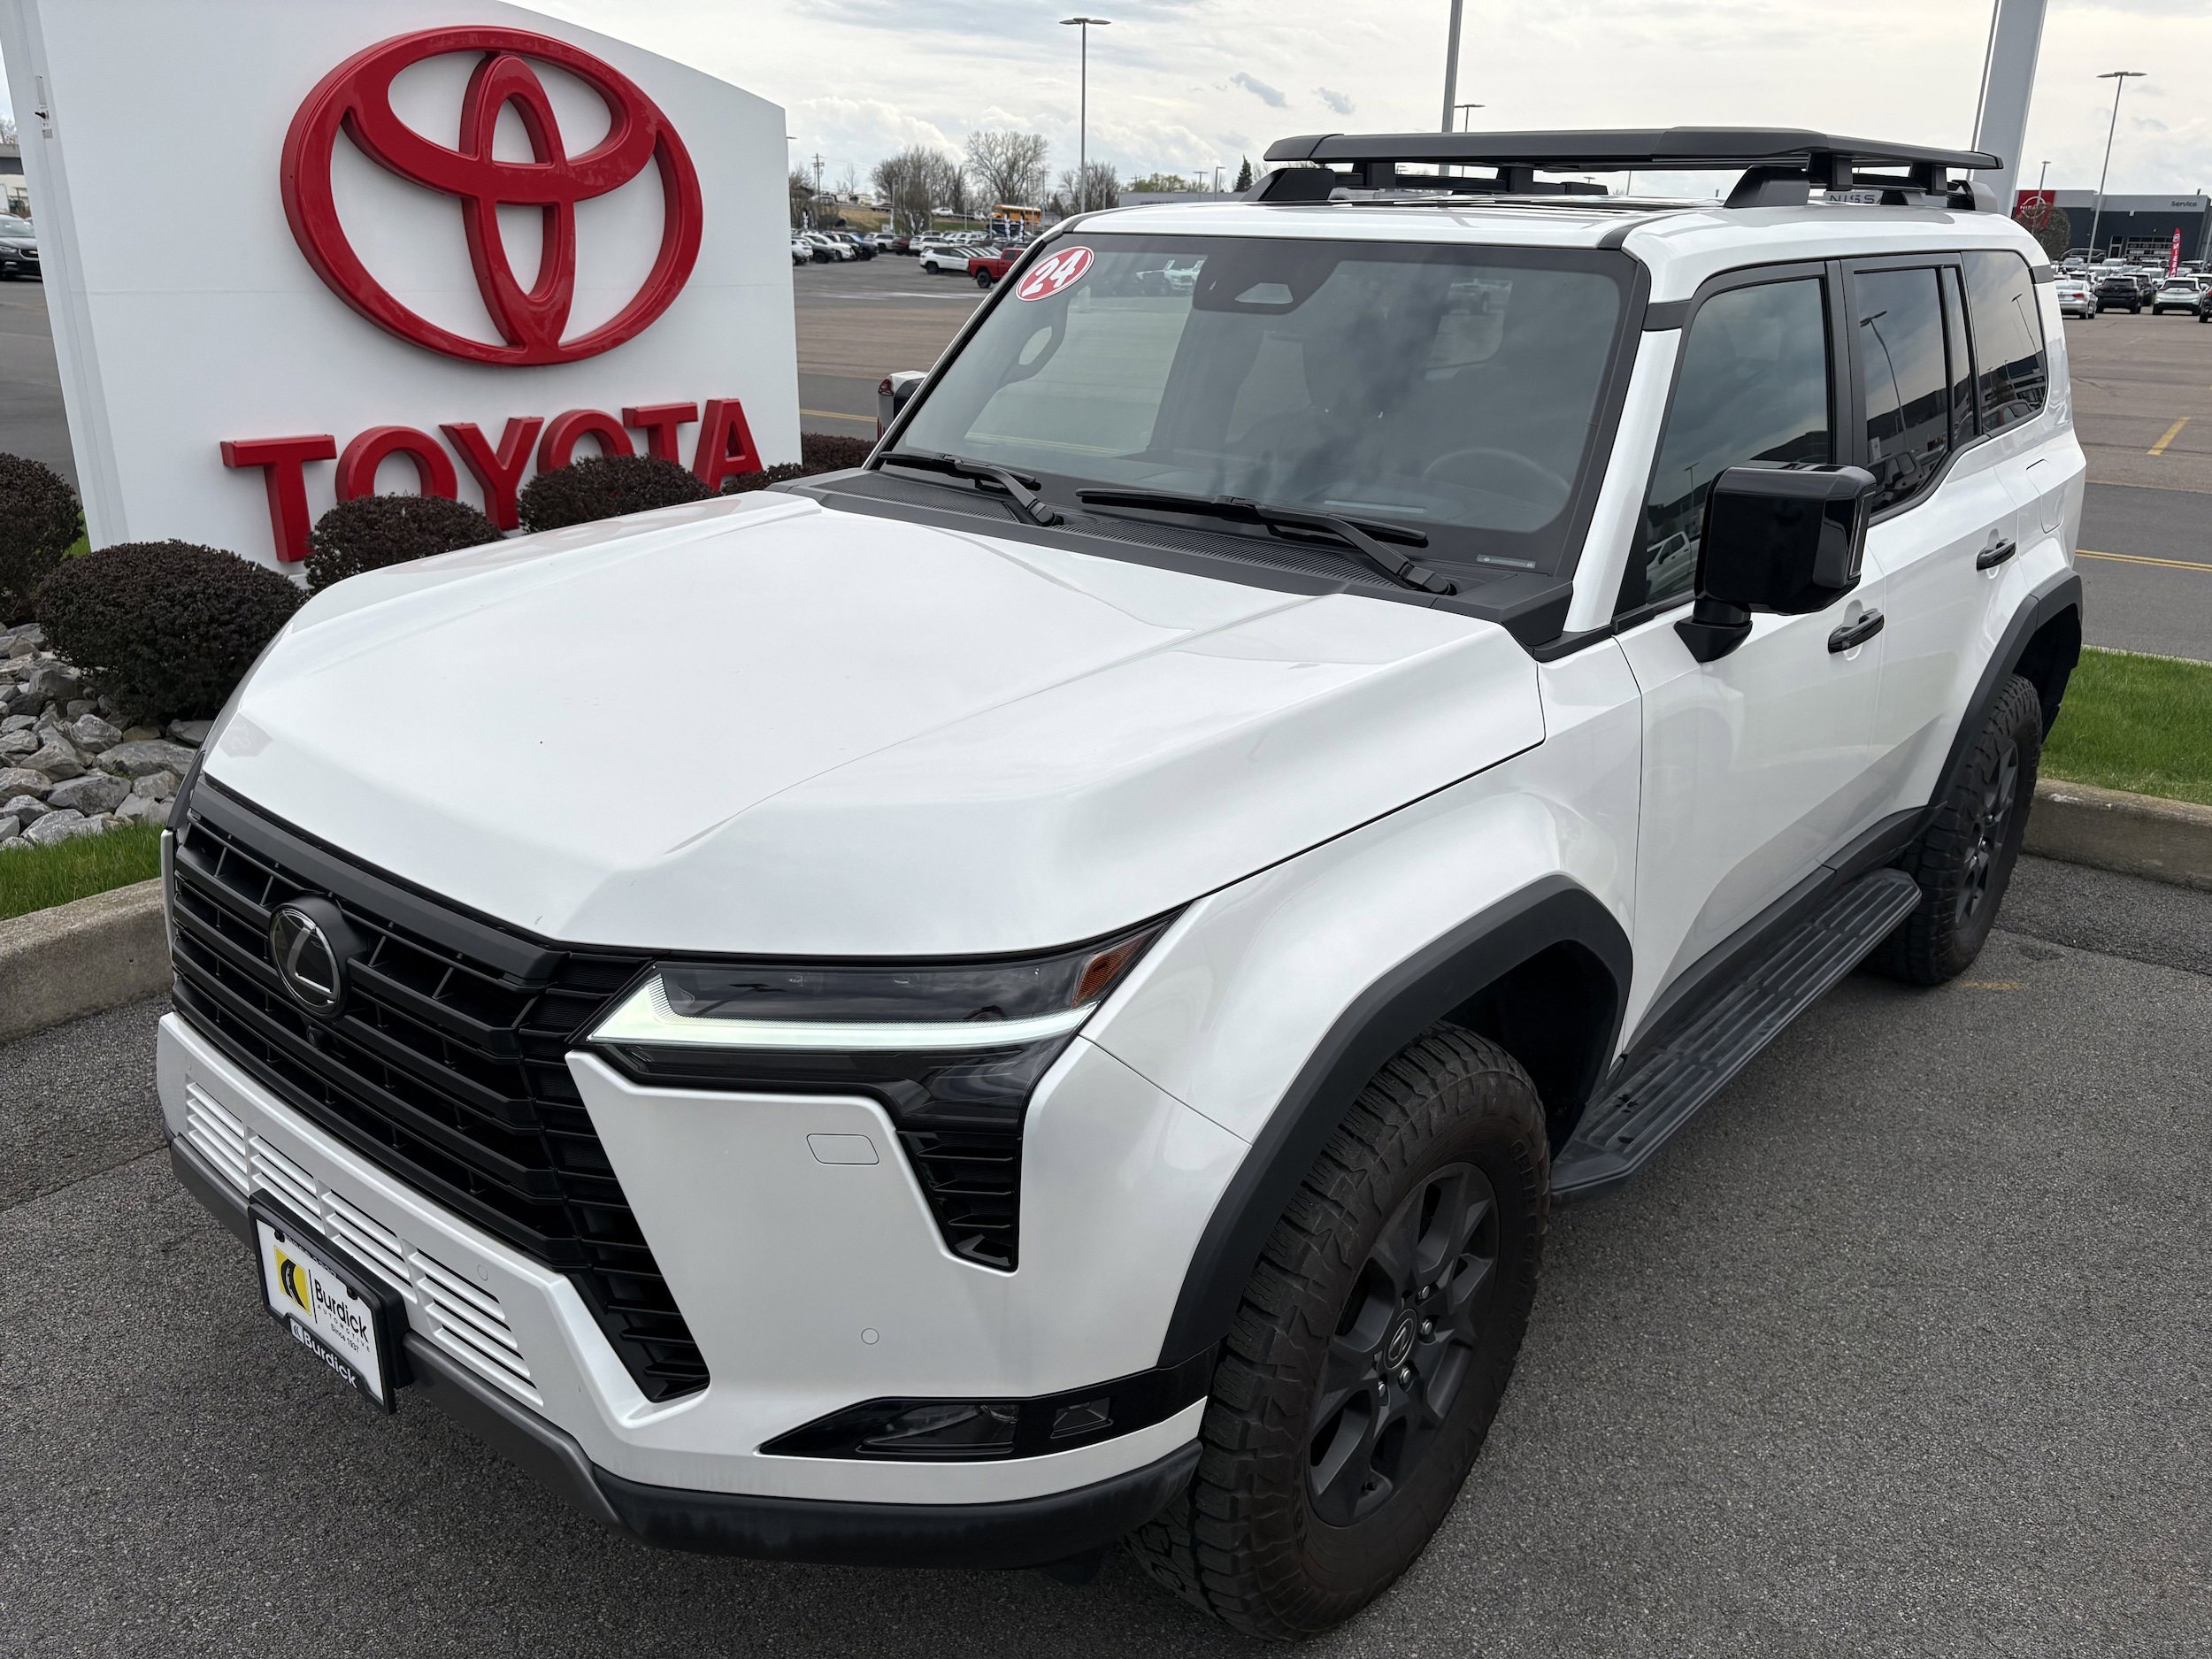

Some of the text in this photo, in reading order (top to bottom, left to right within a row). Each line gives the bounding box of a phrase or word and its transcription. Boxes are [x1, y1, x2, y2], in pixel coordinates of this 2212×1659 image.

[1829, 194, 1881, 204] NISS
[1021, 250, 1087, 297] 24
[2170, 242, 2179, 278] NISSA
[220, 398, 764, 562] TOYOTA
[314, 1279, 369, 1343] Burdick
[318, 1304, 370, 1353] AUTOMOTIVE
[330, 1323, 346, 1341] Since
[303, 1330, 357, 1389] Burdick
